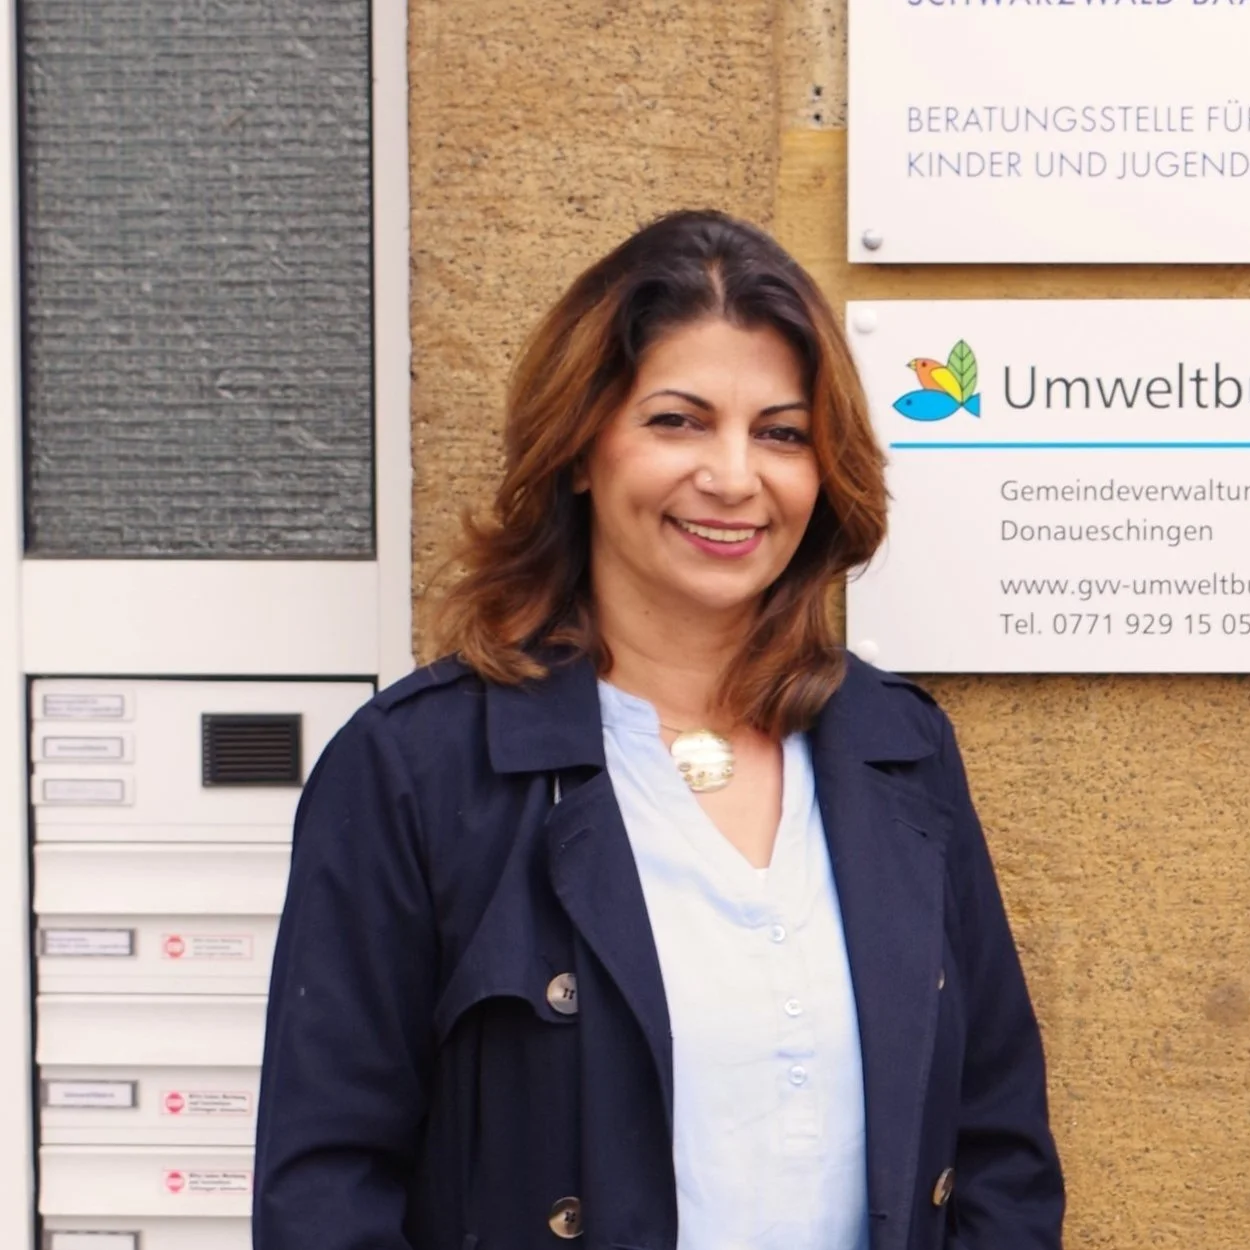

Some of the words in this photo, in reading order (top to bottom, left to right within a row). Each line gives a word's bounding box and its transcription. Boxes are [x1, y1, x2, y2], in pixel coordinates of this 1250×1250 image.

[907, 105, 1195, 133] BERATUNGSSTELLE
[907, 151, 1022, 178] KINDER
[1035, 151, 1108, 178] UND
[1000, 518, 1214, 547] Donaueschingen
[1000, 611, 1042, 636] Tel.
[1052, 612, 1112, 636] 0771
[1124, 612, 1174, 636] 929
[1184, 612, 1212, 636] 15
